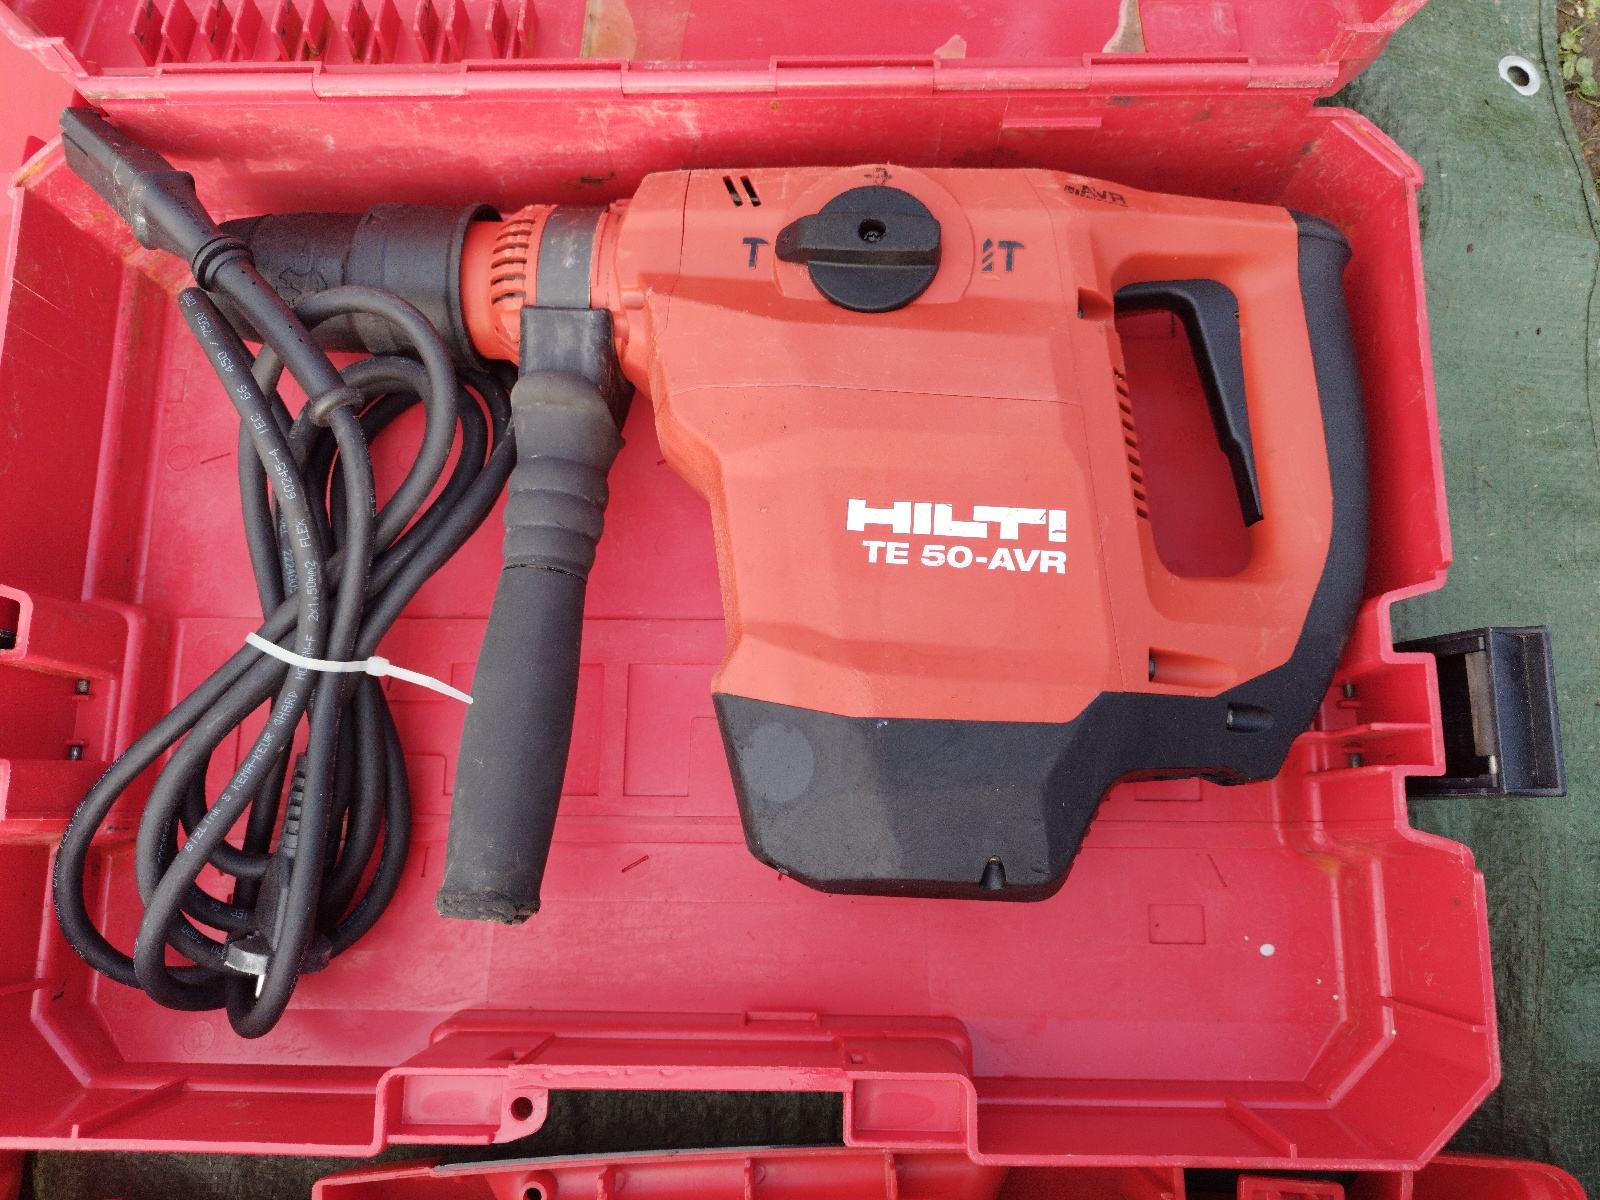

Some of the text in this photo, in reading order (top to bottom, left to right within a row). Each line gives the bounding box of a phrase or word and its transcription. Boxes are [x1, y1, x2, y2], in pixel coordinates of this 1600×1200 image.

[250, 413, 269, 434] IEC
[296, 518, 311, 548] FLEX
[847, 498, 1067, 543] HILTI
[862, 540, 1067, 575] TE 50-AVR
